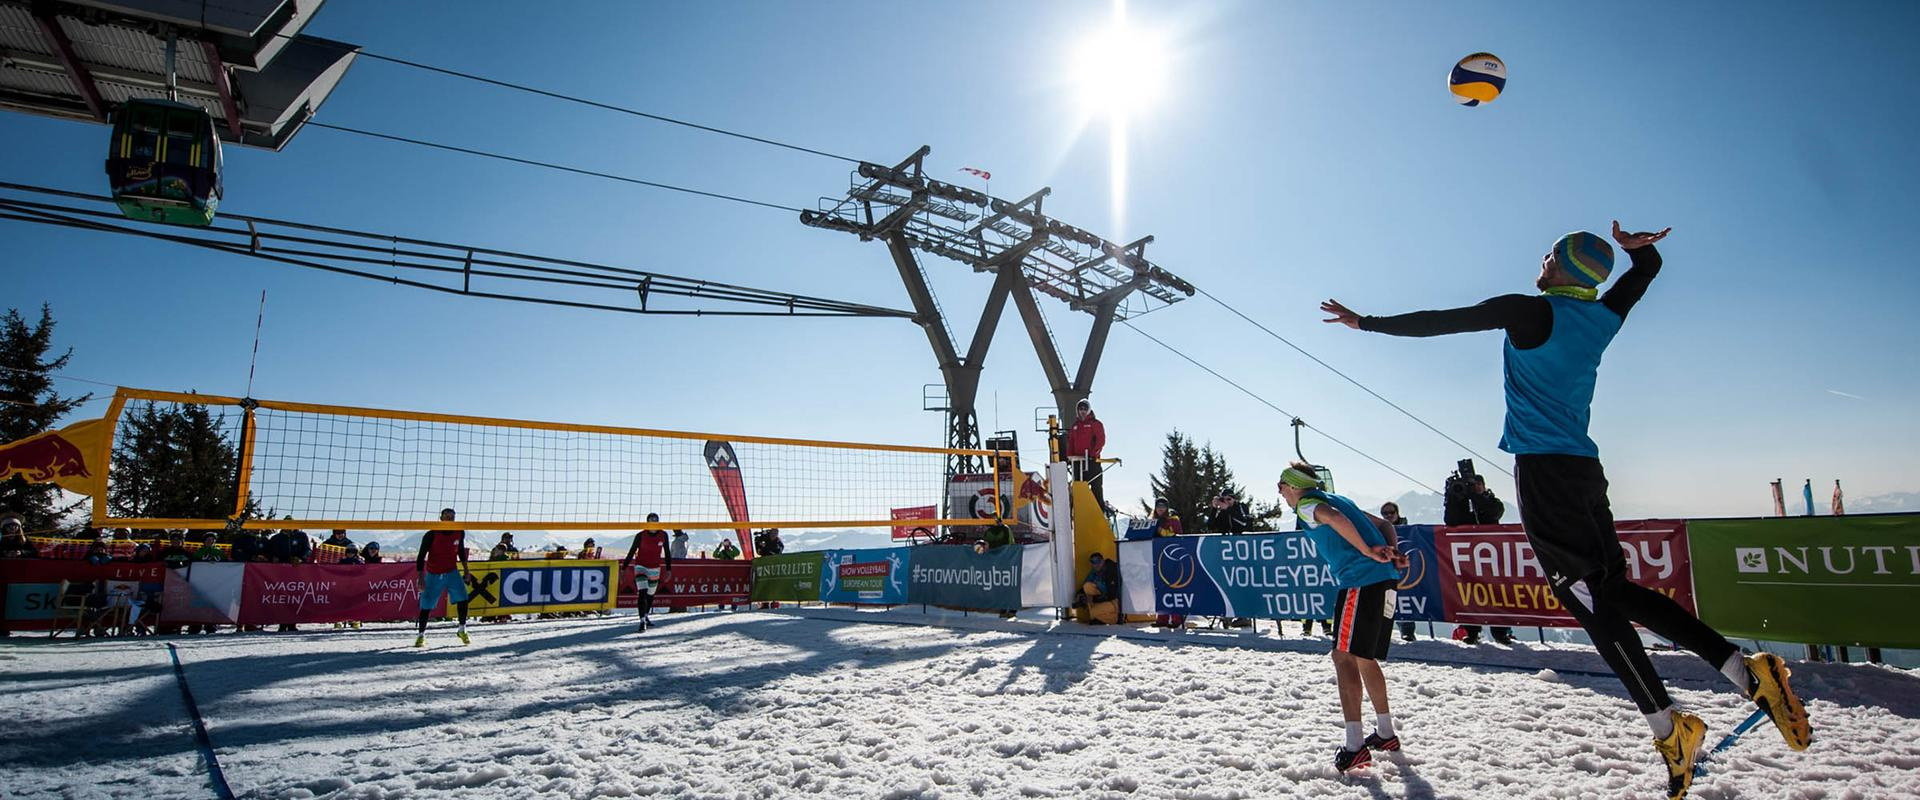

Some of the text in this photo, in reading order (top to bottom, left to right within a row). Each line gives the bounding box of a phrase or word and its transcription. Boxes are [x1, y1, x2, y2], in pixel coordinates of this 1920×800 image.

[1221, 537, 1317, 560] 2016 SN
[115, 568, 158, 577] LIVE
[762, 562, 814, 576] NUTRILITE
[858, 565, 887, 575] VOLLEYBALL
[1222, 564, 1341, 587] VOLLEYBA
[913, 564, 1018, 591] #snowvolleyball
[264, 581, 330, 593] WAGRAIN
[368, 580, 420, 592] WAGRA
[503, 569, 607, 604] CLUB
[674, 583, 749, 593] WAGRAIN
[1163, 593, 1194, 608] CEV
[1262, 593, 1326, 615] TOUR
[1457, 582, 1567, 610] VOLLEYB
[1395, 596, 1427, 614] EV
